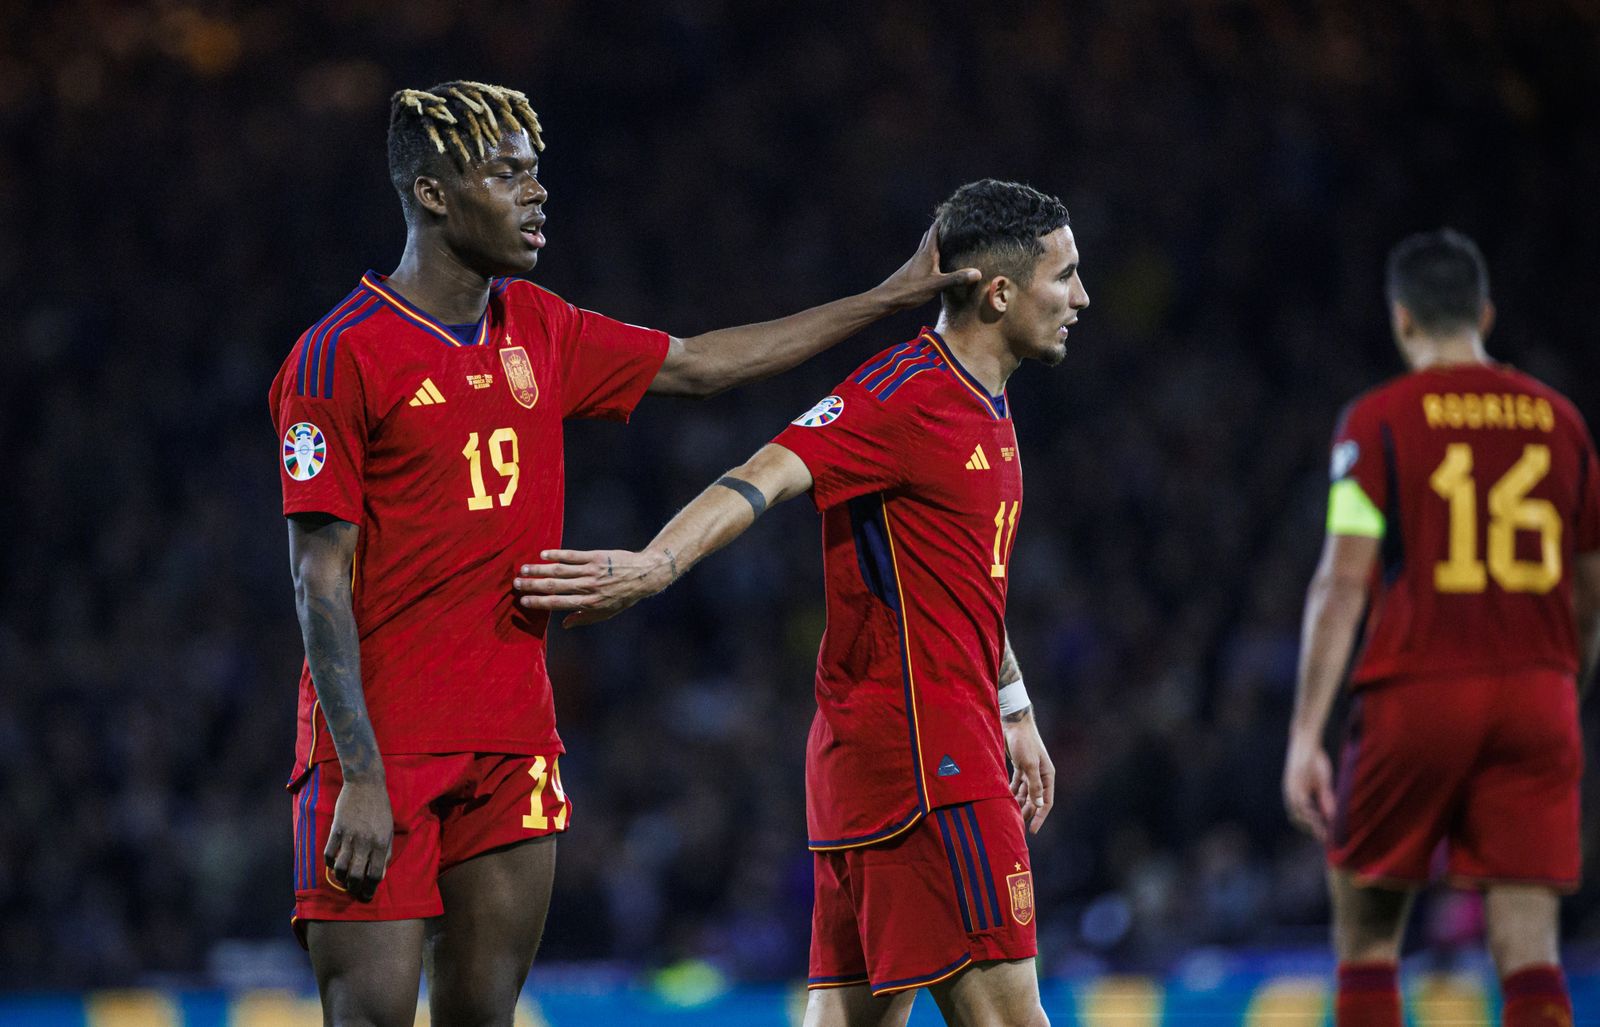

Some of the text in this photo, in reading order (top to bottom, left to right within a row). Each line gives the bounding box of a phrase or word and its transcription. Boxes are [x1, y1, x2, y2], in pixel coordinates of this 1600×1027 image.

[1423, 393, 1555, 432] RODRIGO
[462, 427, 519, 511] 19
[991, 501, 1018, 577] 11
[1430, 443, 1562, 593] 16
